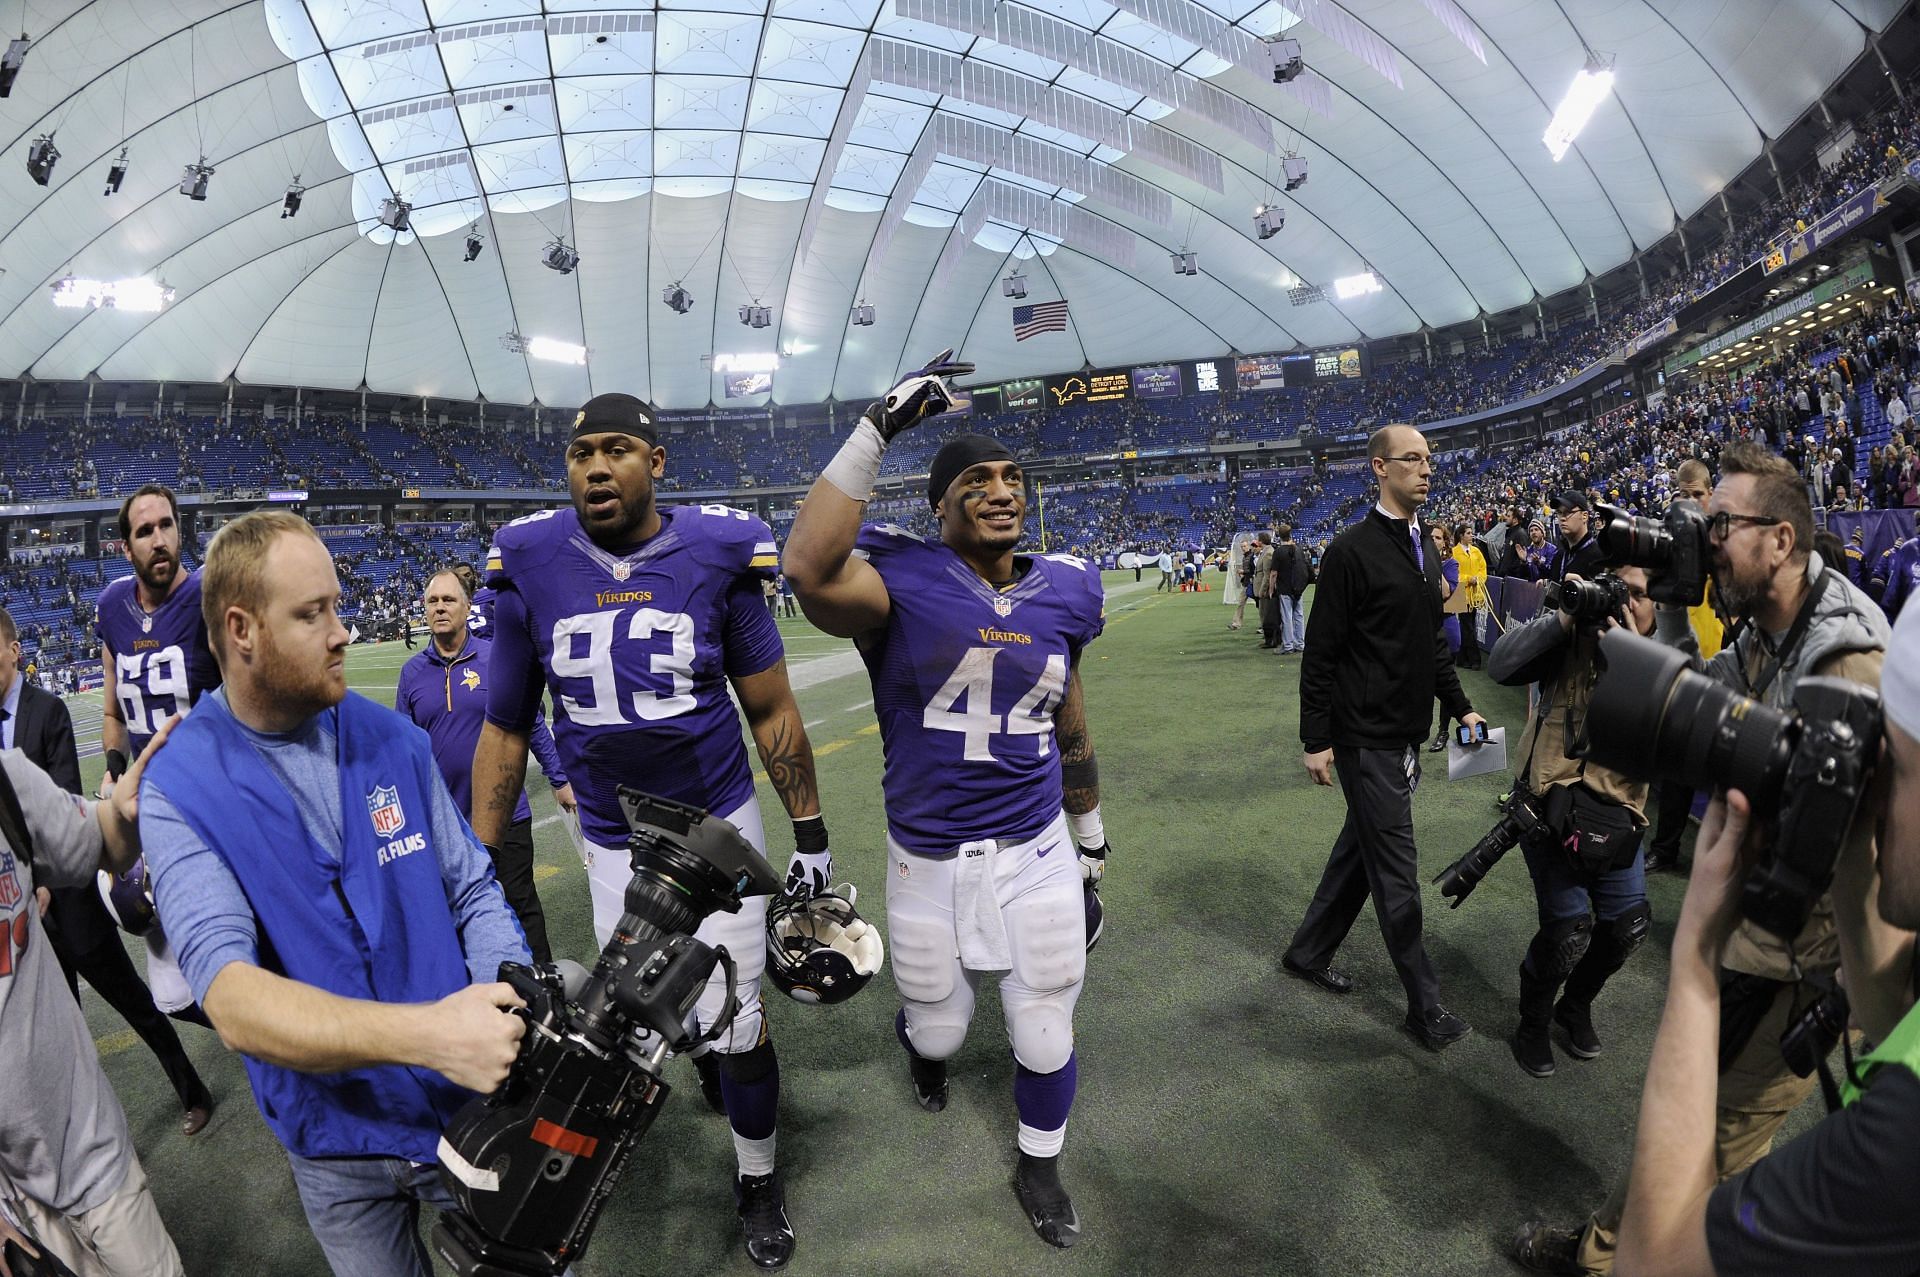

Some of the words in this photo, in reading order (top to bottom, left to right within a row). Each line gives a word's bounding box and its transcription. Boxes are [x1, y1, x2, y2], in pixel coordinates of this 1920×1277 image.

[1736, 321, 1754, 340] HOME
[1755, 313, 1774, 333] FIELD
[1773, 290, 1817, 322] ADVANTAGE!
[1091, 380, 1112, 388] DETROIT
[1315, 362, 1338, 371] FAST.
[551, 607, 698, 726] 93
[116, 645, 192, 735] 69
[923, 647, 1067, 762] 44
[373, 806, 400, 831] NFL
[388, 833, 426, 860] FILMS
